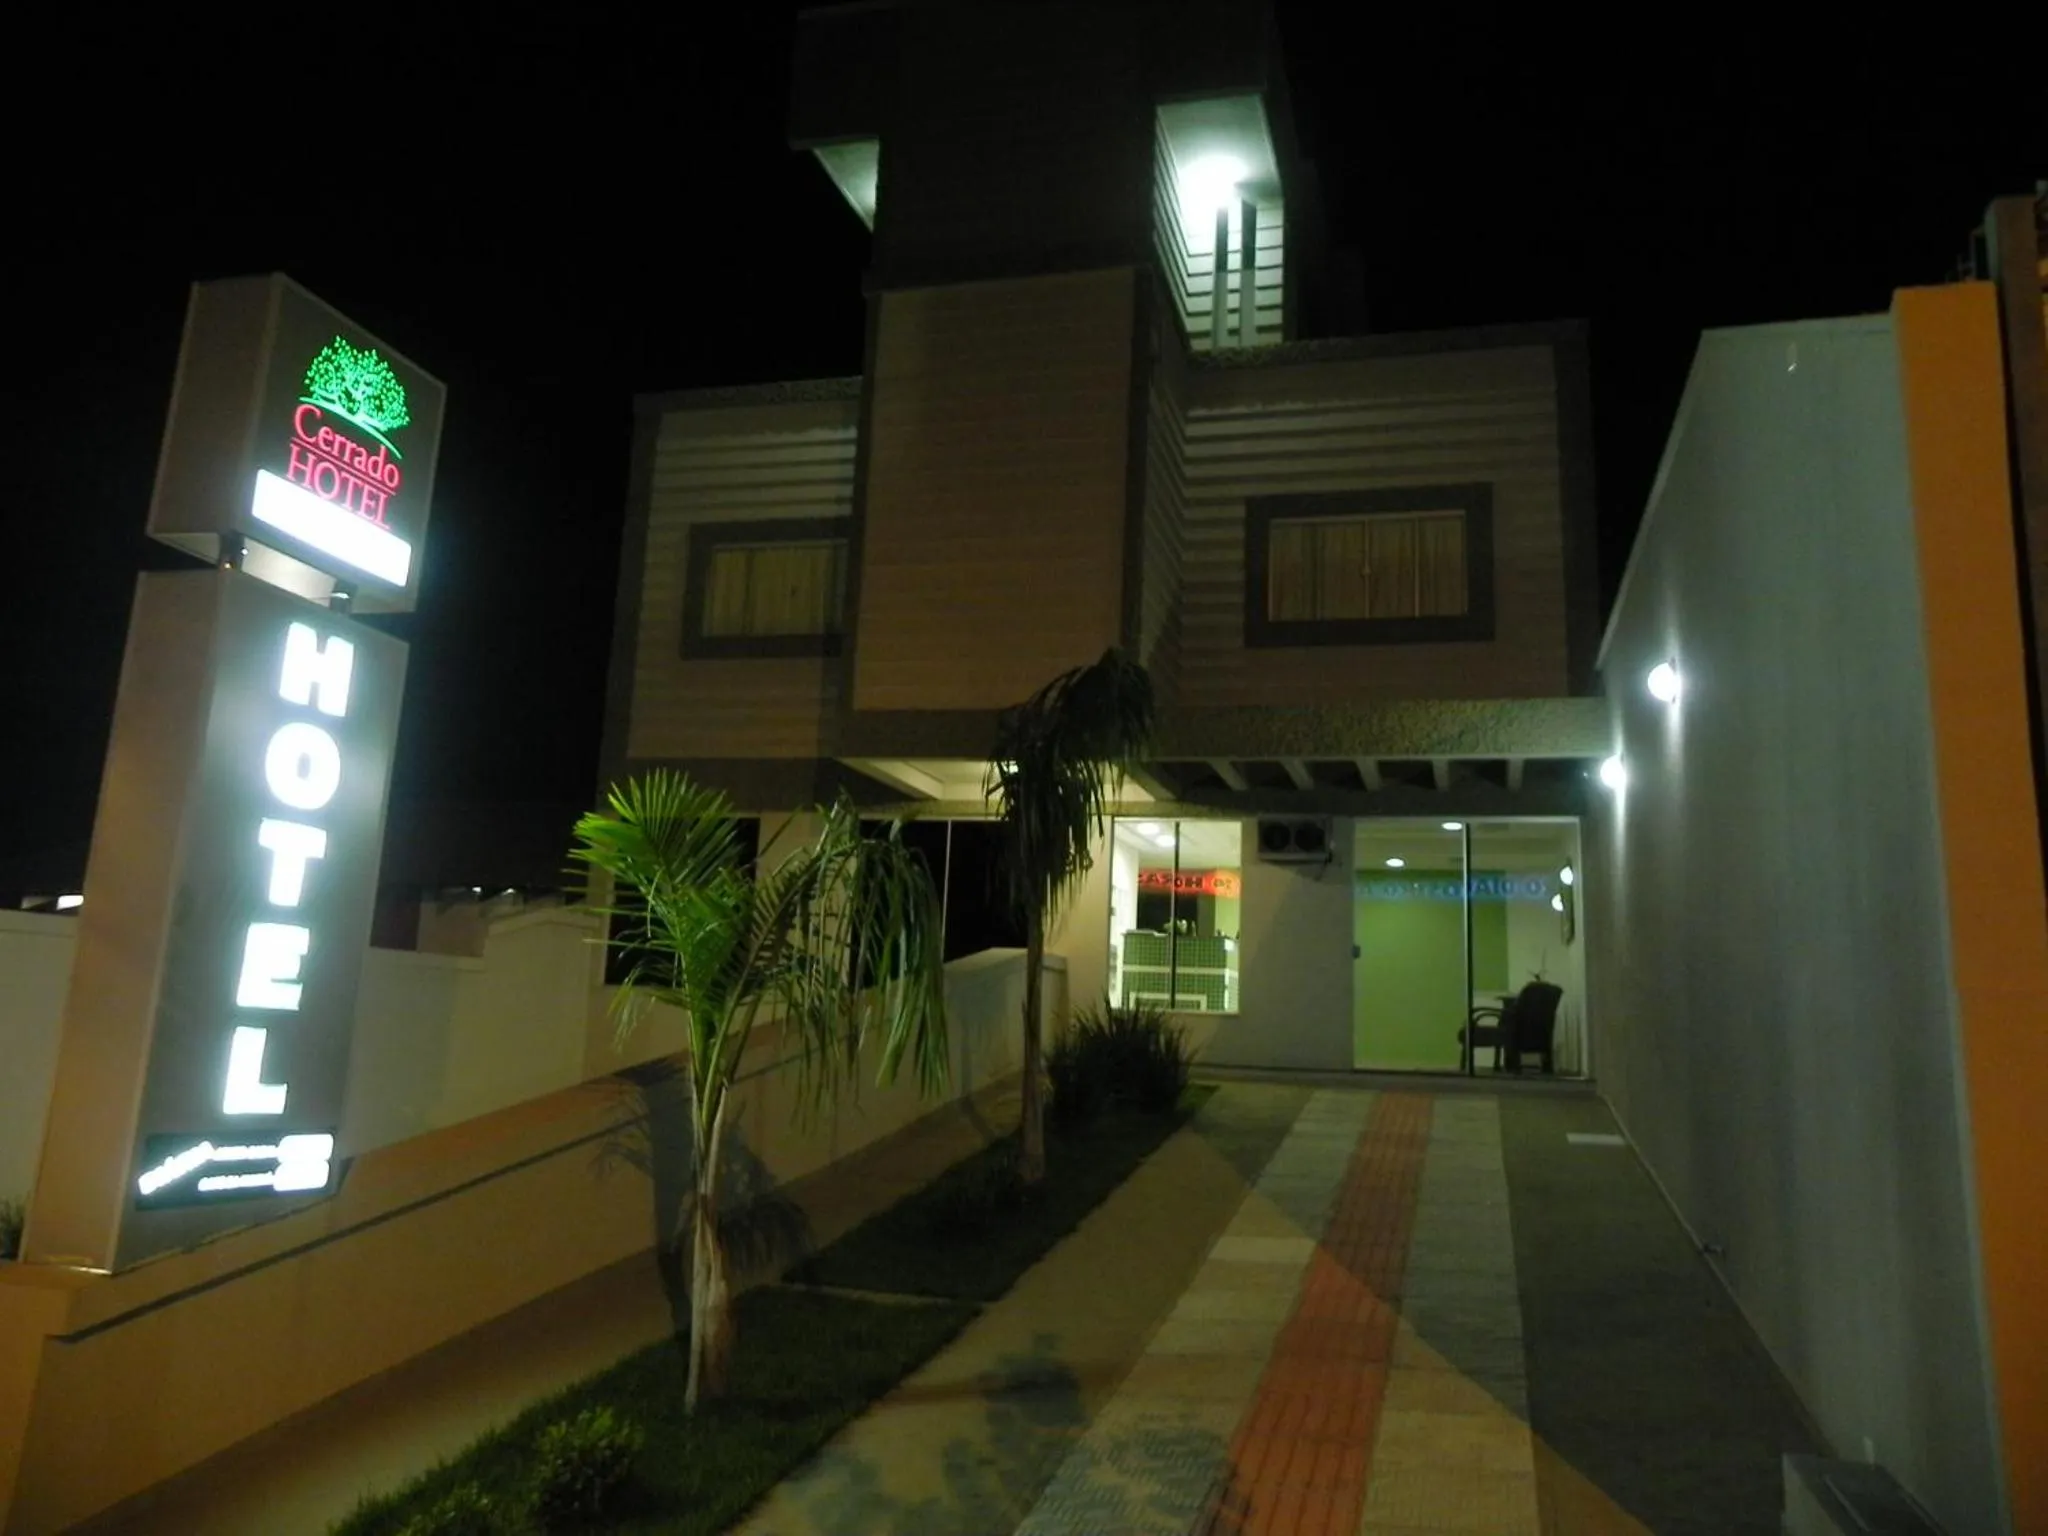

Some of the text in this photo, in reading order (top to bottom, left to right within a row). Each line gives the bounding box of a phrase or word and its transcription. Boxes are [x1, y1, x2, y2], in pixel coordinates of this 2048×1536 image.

[287, 445, 390, 528] HOTEL
[295, 405, 400, 487] Cerrado
[223, 622, 354, 1114] HOTEL
